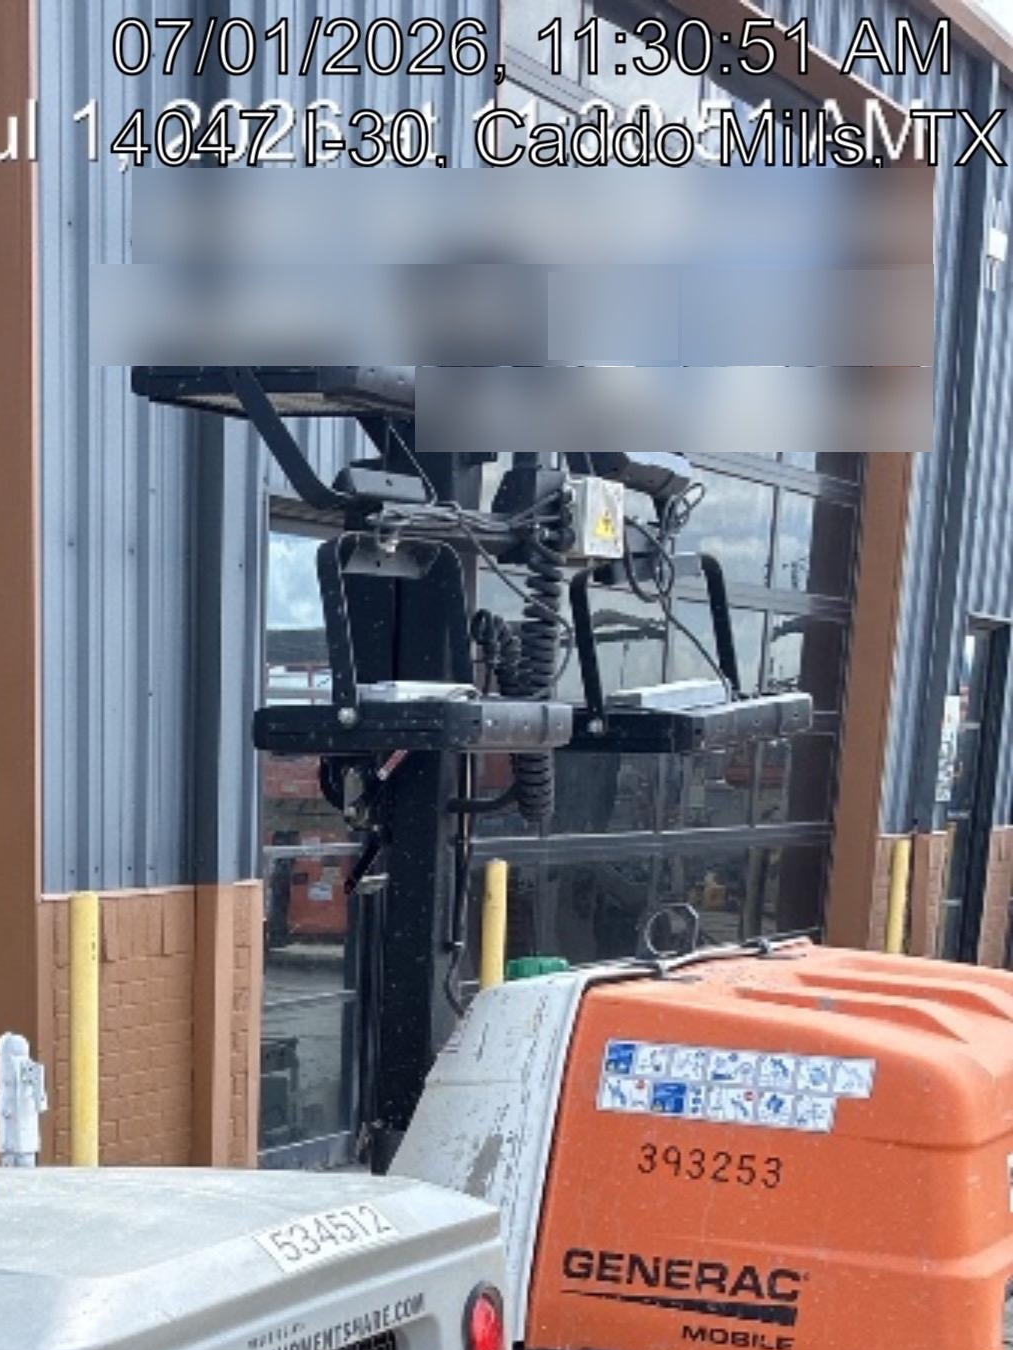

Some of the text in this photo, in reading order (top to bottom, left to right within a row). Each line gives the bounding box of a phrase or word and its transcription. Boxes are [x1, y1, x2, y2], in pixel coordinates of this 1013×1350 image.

[638, 1143, 783, 1188] 393253
[269, 1205, 391, 1261] 534512
[562, 1248, 802, 1302] GENERAC
